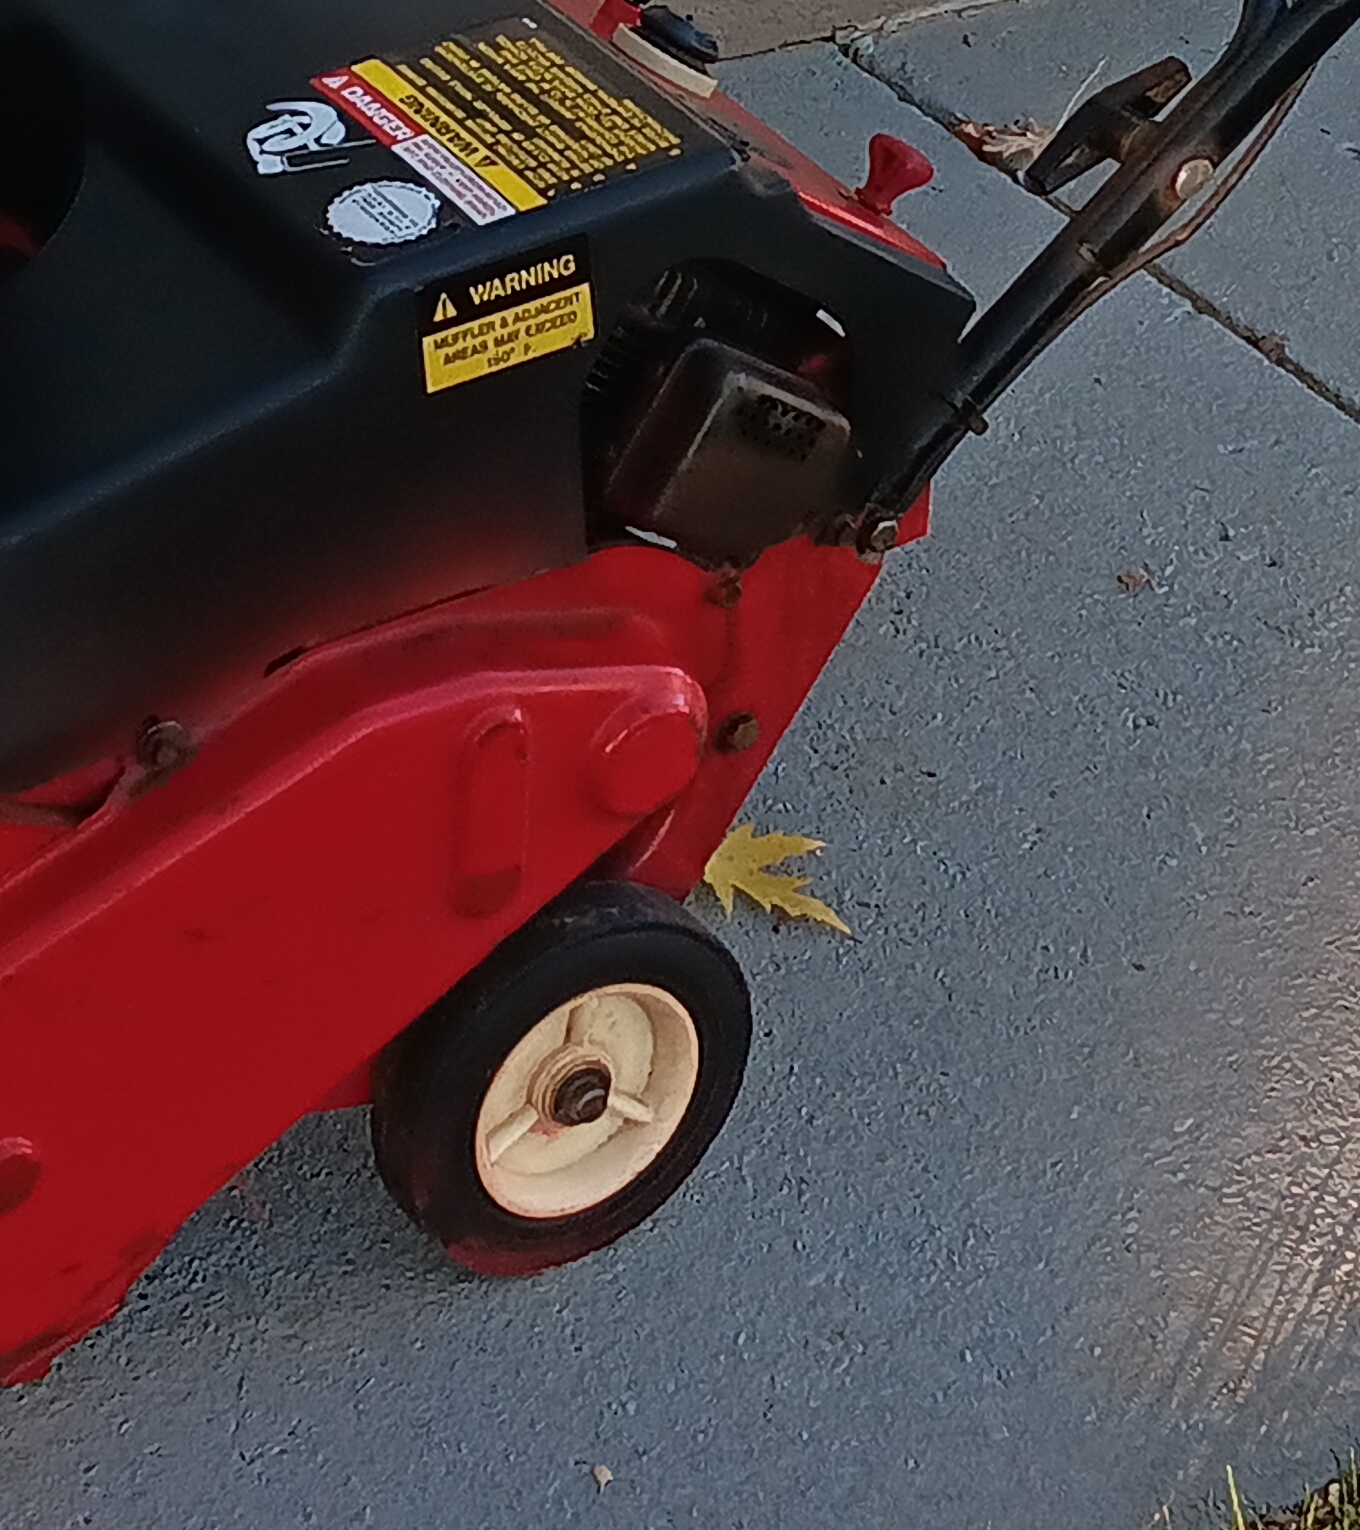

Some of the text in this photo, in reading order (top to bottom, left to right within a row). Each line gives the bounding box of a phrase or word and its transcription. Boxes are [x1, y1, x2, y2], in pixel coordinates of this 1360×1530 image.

[341, 86, 415, 141] DANGER
[398, 94, 479, 158] WARNING
[469, 254, 576, 305] WARNING
[433, 319, 496, 350] MUFFLER
[512, 291, 582, 325] ADJACENT
[443, 339, 488, 366] AREAS
[493, 327, 521, 348] MAY
